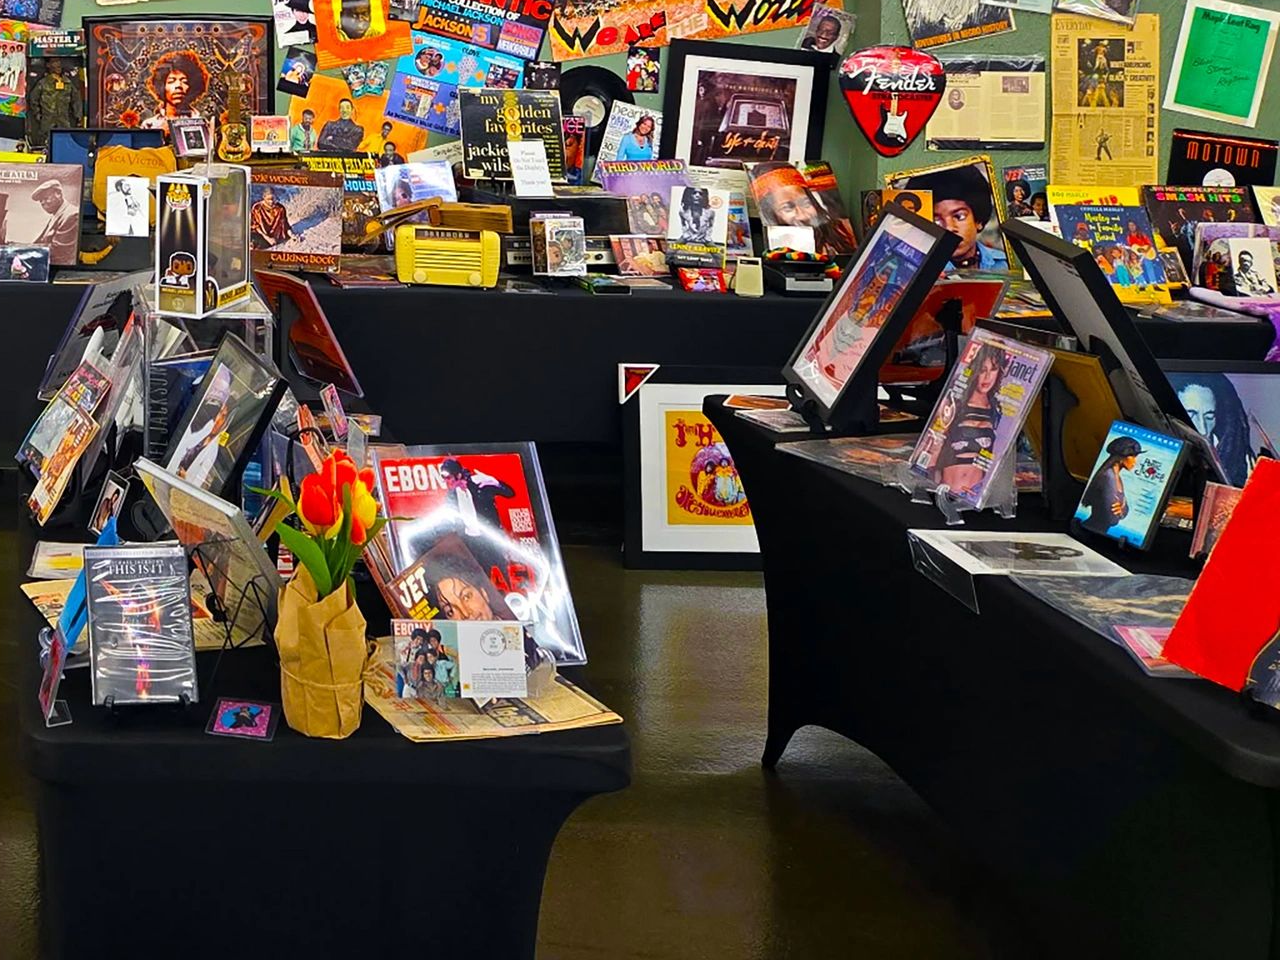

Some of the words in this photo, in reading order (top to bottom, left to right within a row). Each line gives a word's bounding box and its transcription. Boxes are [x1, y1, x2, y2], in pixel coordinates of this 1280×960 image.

[463, 8, 505, 26] JACKSON
[506, 11, 521, 21] OF
[1055, 20, 1092, 31] EVERYDAY
[34, 36, 71, 44] MASTER
[554, 15, 619, 54] We
[667, 14, 708, 37] THE
[842, 61, 937, 94] Fender
[481, 95, 500, 109] my
[467, 142, 509, 160] jackie
[1186, 141, 1260, 169] MOTOWN
[109, 156, 130, 166] RCA
[602, 162, 638, 173] THIRD
[639, 160, 683, 173] WORLD
[269, 174, 310, 185] WONDER
[1156, 192, 1207, 203] SMASH
[1209, 193, 1242, 204] HITS
[271, 253, 309, 262] TALKING
[1008, 355, 1038, 382] janet
[384, 461, 449, 493] EBON
[108, 563, 135, 575] THIS
[397, 566, 430, 609] JET
